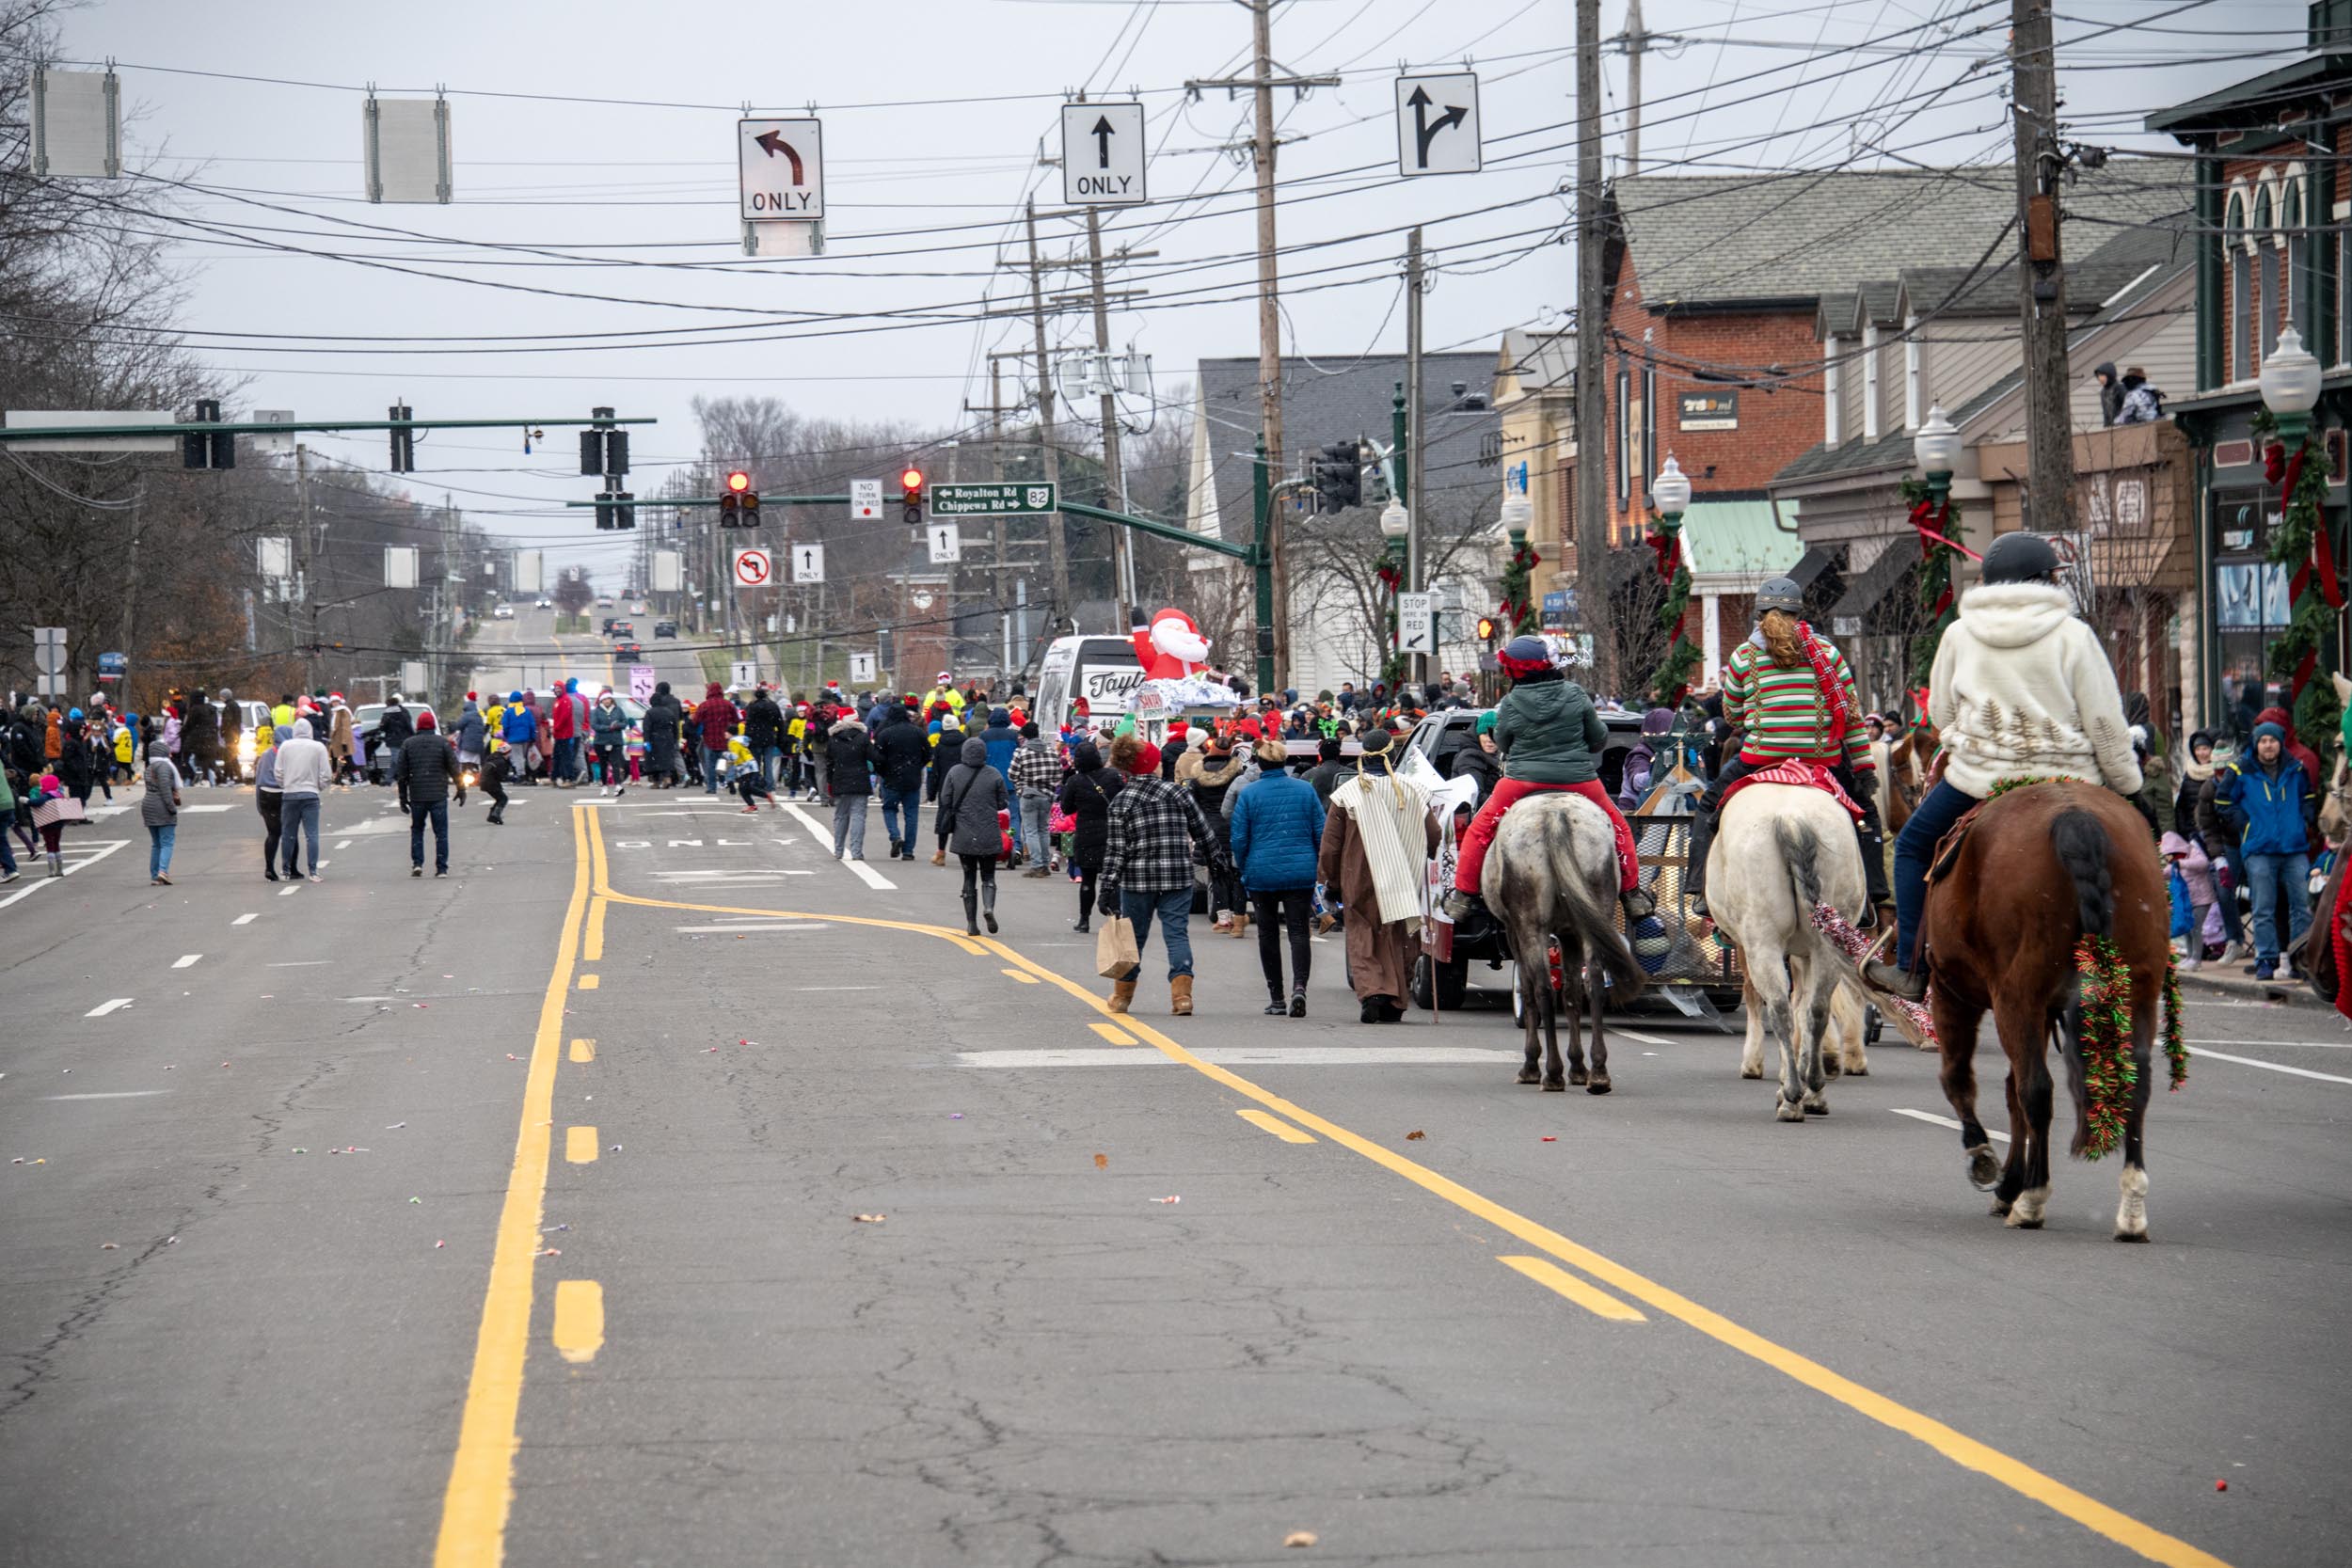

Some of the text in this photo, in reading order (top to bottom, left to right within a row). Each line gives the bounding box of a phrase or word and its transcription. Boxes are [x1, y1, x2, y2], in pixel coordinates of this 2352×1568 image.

[1077, 175, 1132, 195] ONLY
[753, 192, 812, 211] ONLY
[860, 483, 874, 491] NO
[955, 487, 1017, 499] Royalton Rd
[1029, 491, 1047, 503] 82
[939, 499, 1006, 512] Chippewa Rd
[934, 550, 956, 560] ONLY
[799, 571, 819, 579] ONLY
[1403, 598, 1428, 610] STOP
[1406, 621, 1424, 630] RED
[616, 838, 800, 848] ONLY
